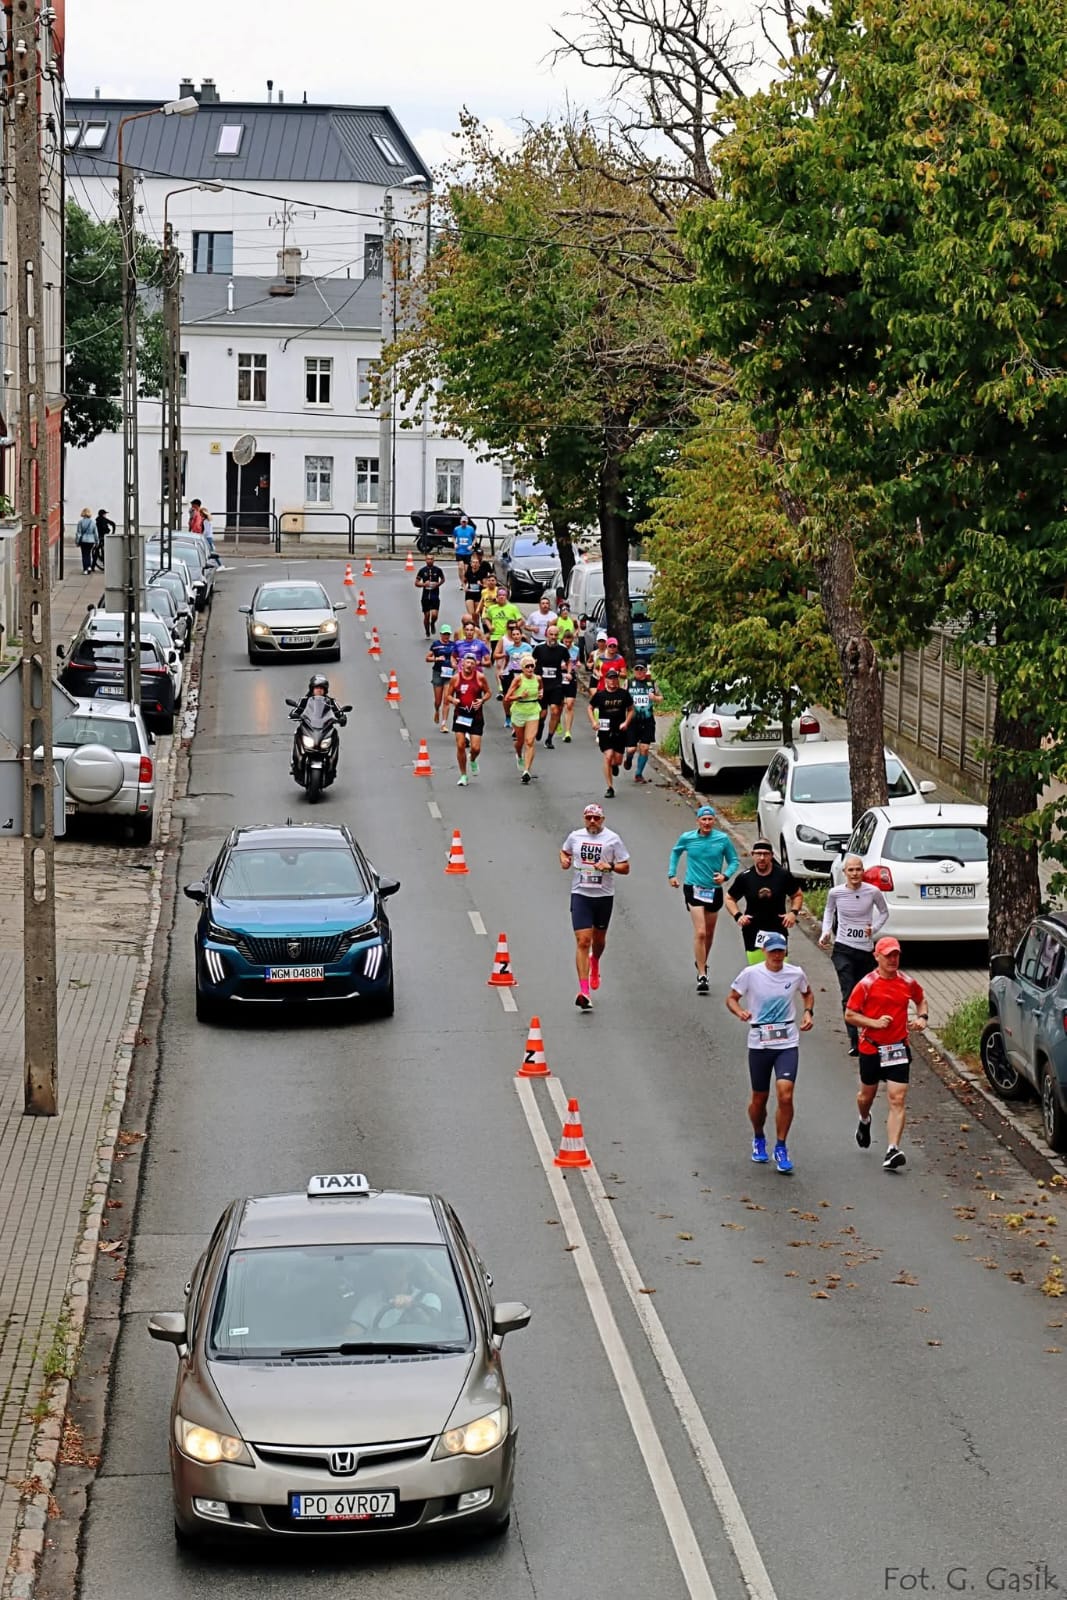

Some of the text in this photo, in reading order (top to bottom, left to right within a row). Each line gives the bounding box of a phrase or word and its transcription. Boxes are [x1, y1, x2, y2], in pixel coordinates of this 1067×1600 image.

[581, 844, 602, 853] RUN
[580, 852, 601, 862] BDG
[928, 886, 974, 896] CB 178AM
[846, 927, 868, 938] 200
[271, 968, 290, 978] WGM
[315, 1175, 362, 1188] TAXI
[304, 1497, 327, 1514] PO
[334, 1494, 390, 1514] 6VR07
